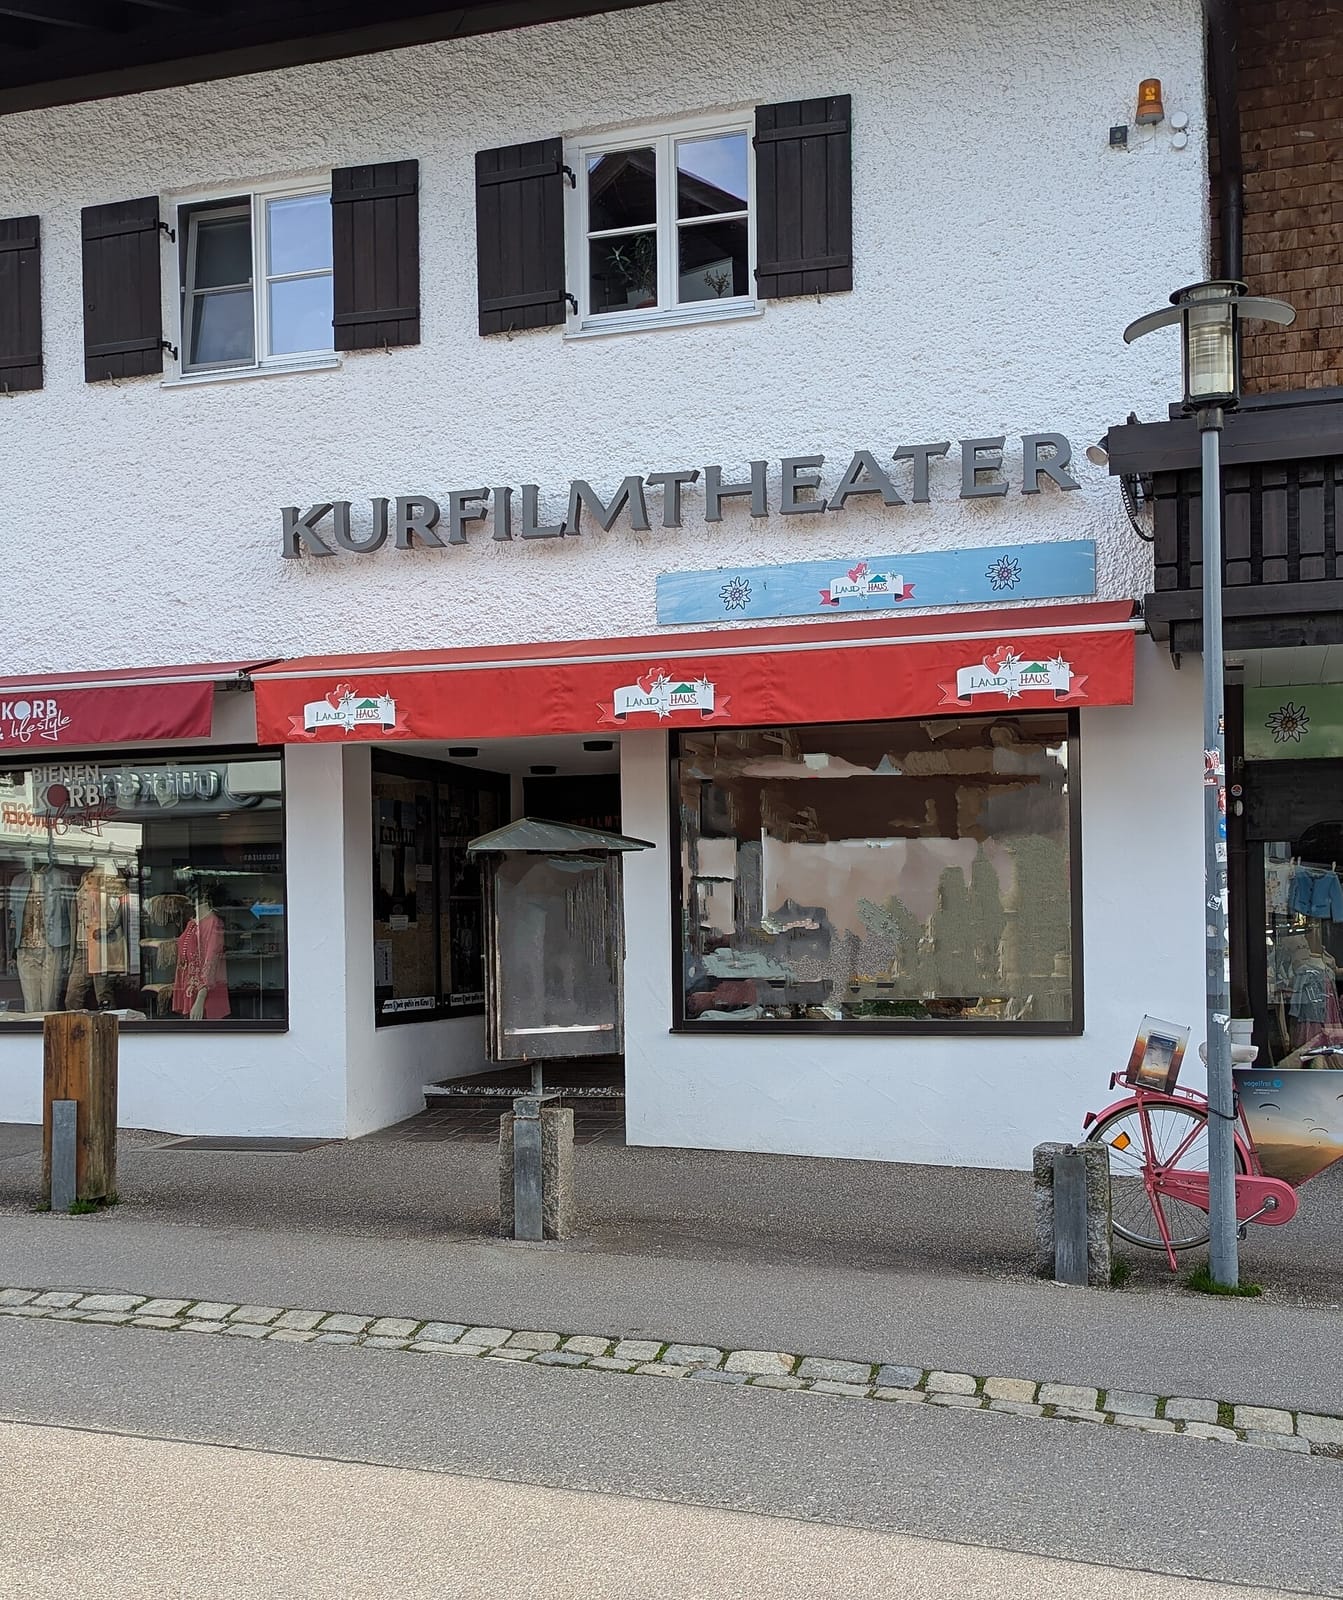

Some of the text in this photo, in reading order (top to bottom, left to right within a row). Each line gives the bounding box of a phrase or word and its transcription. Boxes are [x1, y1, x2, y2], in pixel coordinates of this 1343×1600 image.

[280, 432, 1081, 559] KURFILMTHEATER
[2, 699, 58, 720] KORB
[8, 709, 73, 742] lifestyle
[32, 764, 99, 783] BIENEN
[33, 784, 100, 811] KORB
